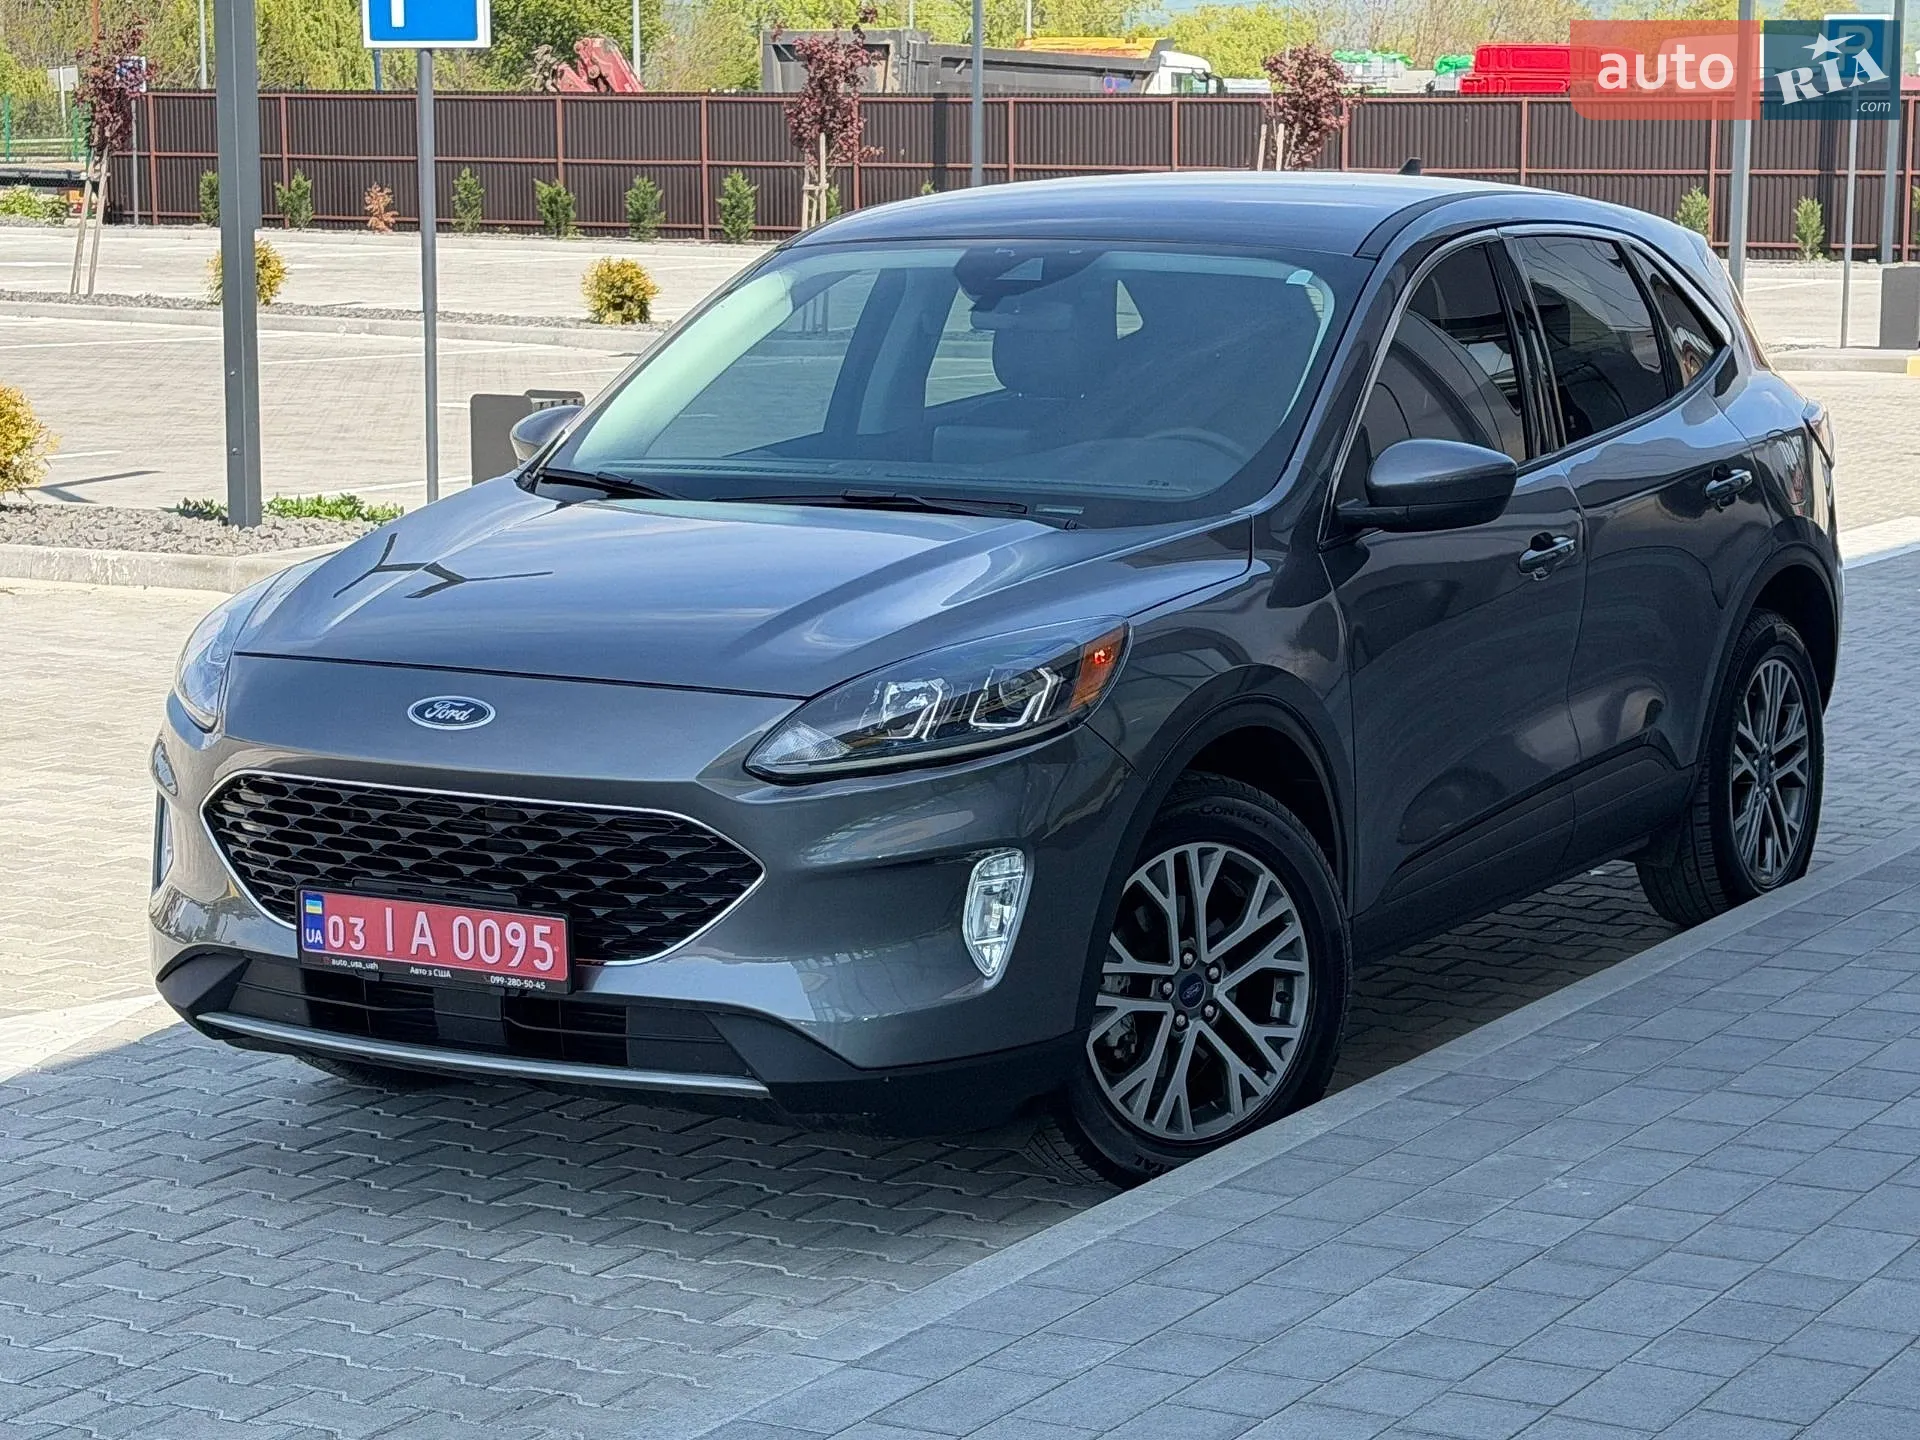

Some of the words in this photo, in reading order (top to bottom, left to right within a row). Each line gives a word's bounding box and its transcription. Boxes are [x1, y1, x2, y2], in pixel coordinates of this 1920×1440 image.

[425, 701, 475, 721] Ford
[306, 928, 323, 945] UA
[327, 915, 366, 951] 03
[452, 915, 555, 971] 0095
[410, 966, 428, 976] Авто
[433, 968, 452, 979] США
[490, 975, 546, 990] 099-280-50-45
